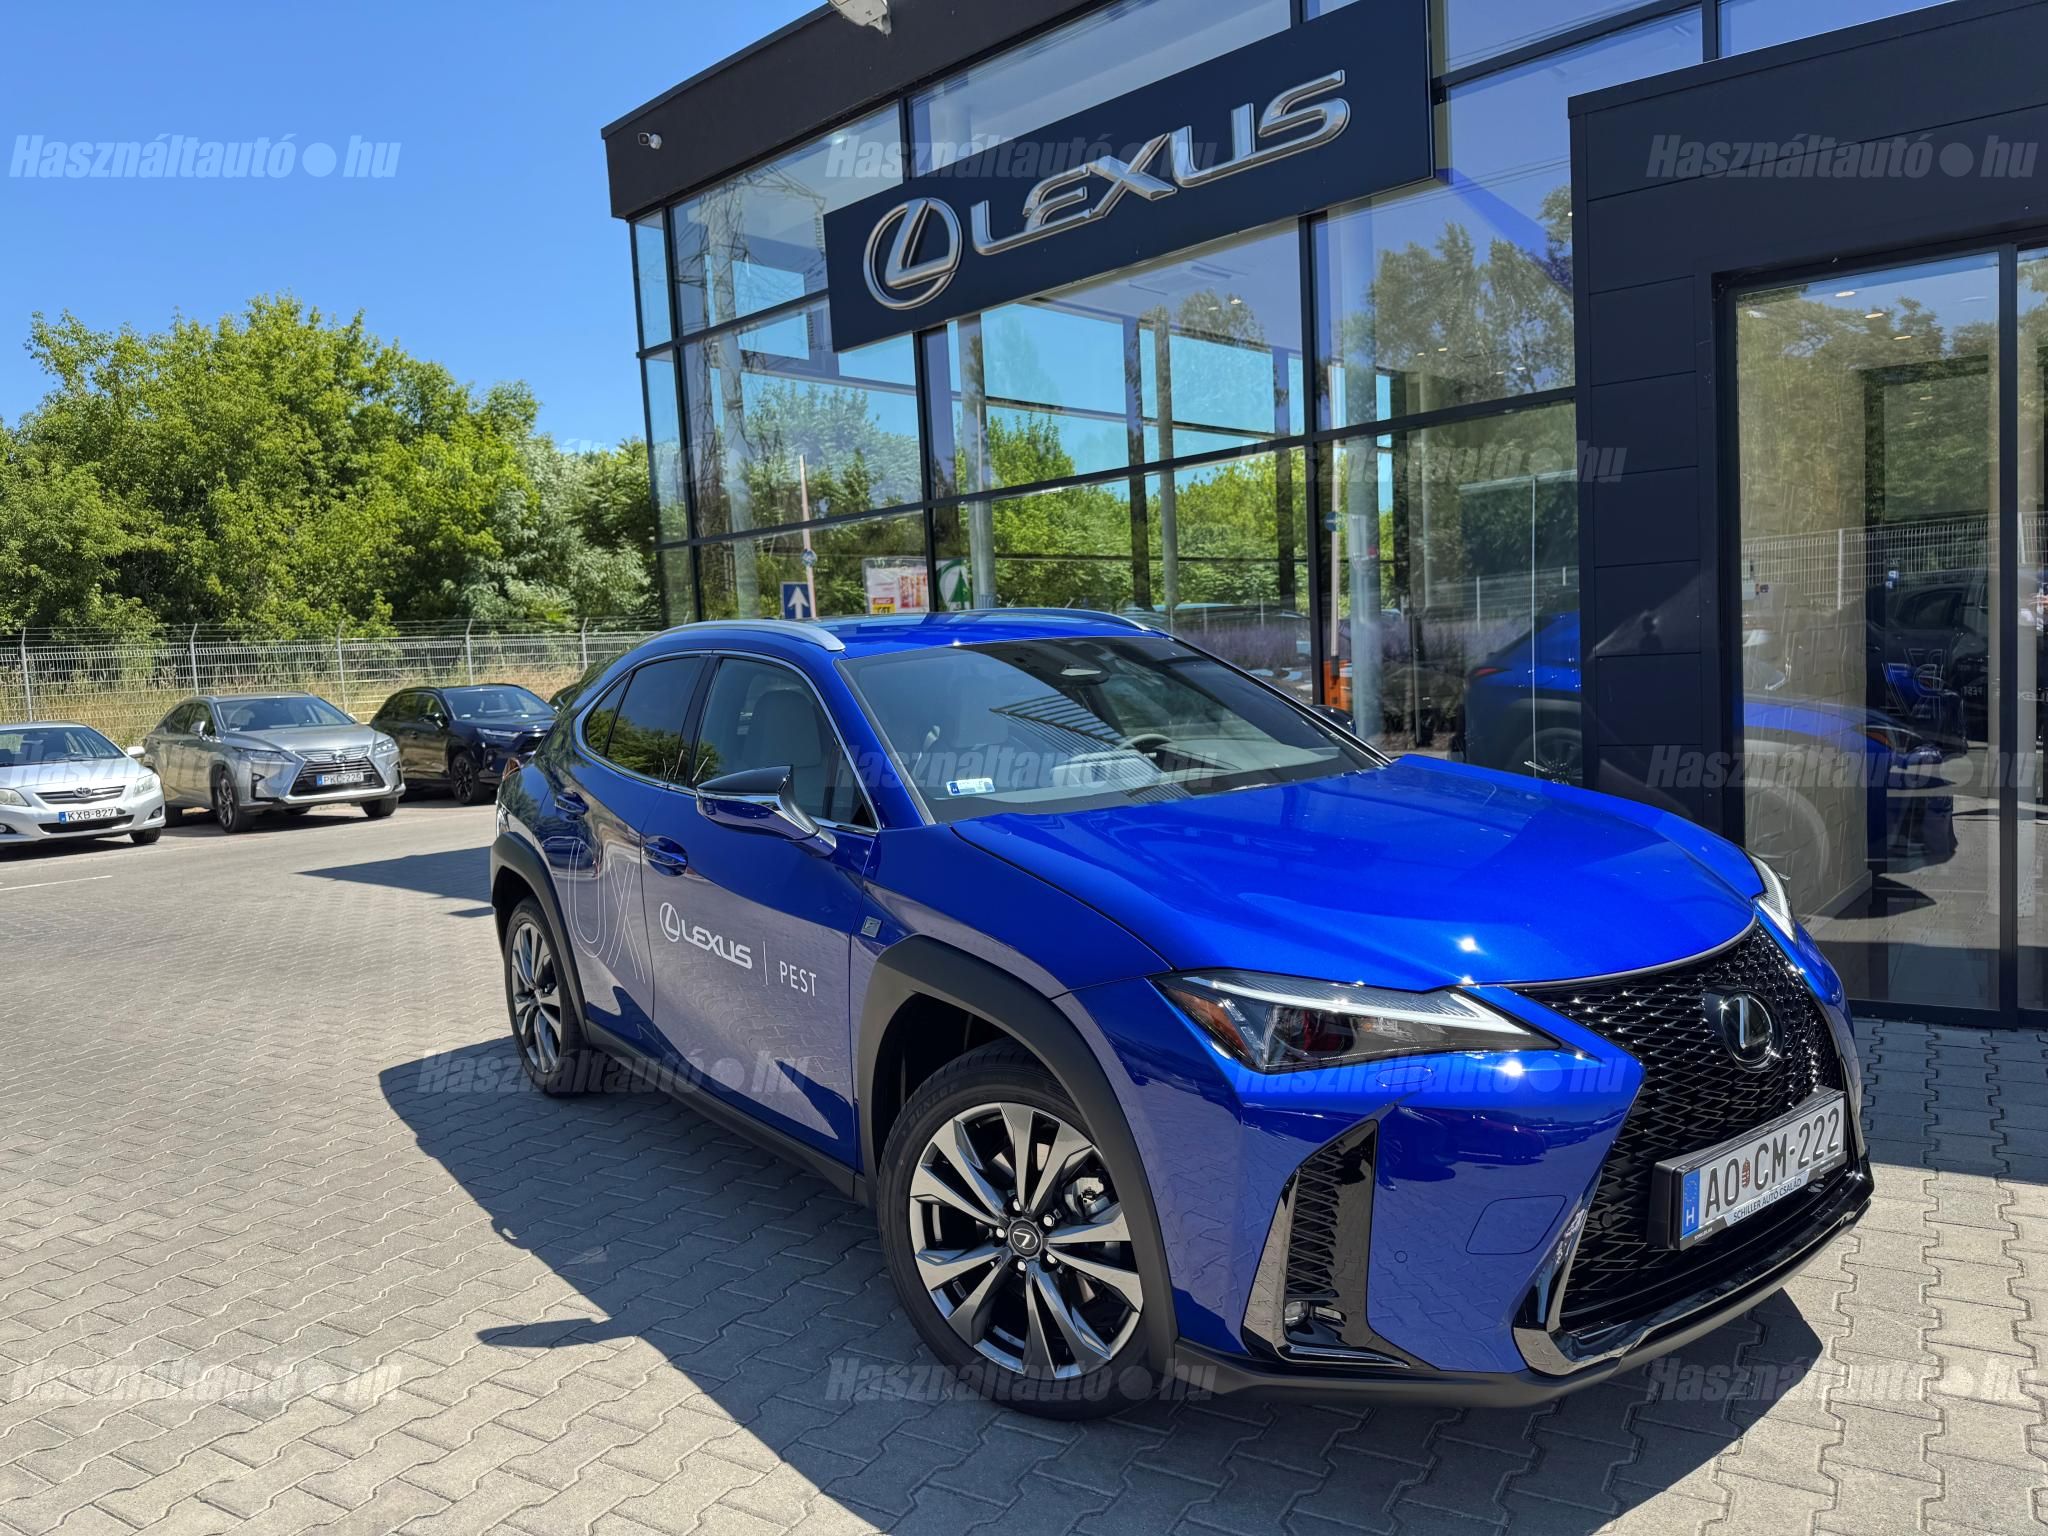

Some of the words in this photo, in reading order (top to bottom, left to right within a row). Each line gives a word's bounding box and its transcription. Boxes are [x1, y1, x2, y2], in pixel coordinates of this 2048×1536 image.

[970, 69, 1351, 256] LEXUS
[67, 808, 114, 821] KXB-827
[682, 919, 752, 969] LEXUS
[780, 960, 816, 997] PEST
[1754, 1107, 1840, 1191] CM-222
[1686, 1206, 1695, 1227] H
[1733, 1198, 1761, 1222] SCHILLER
[1779, 1177, 1802, 1197] CSALÁD
